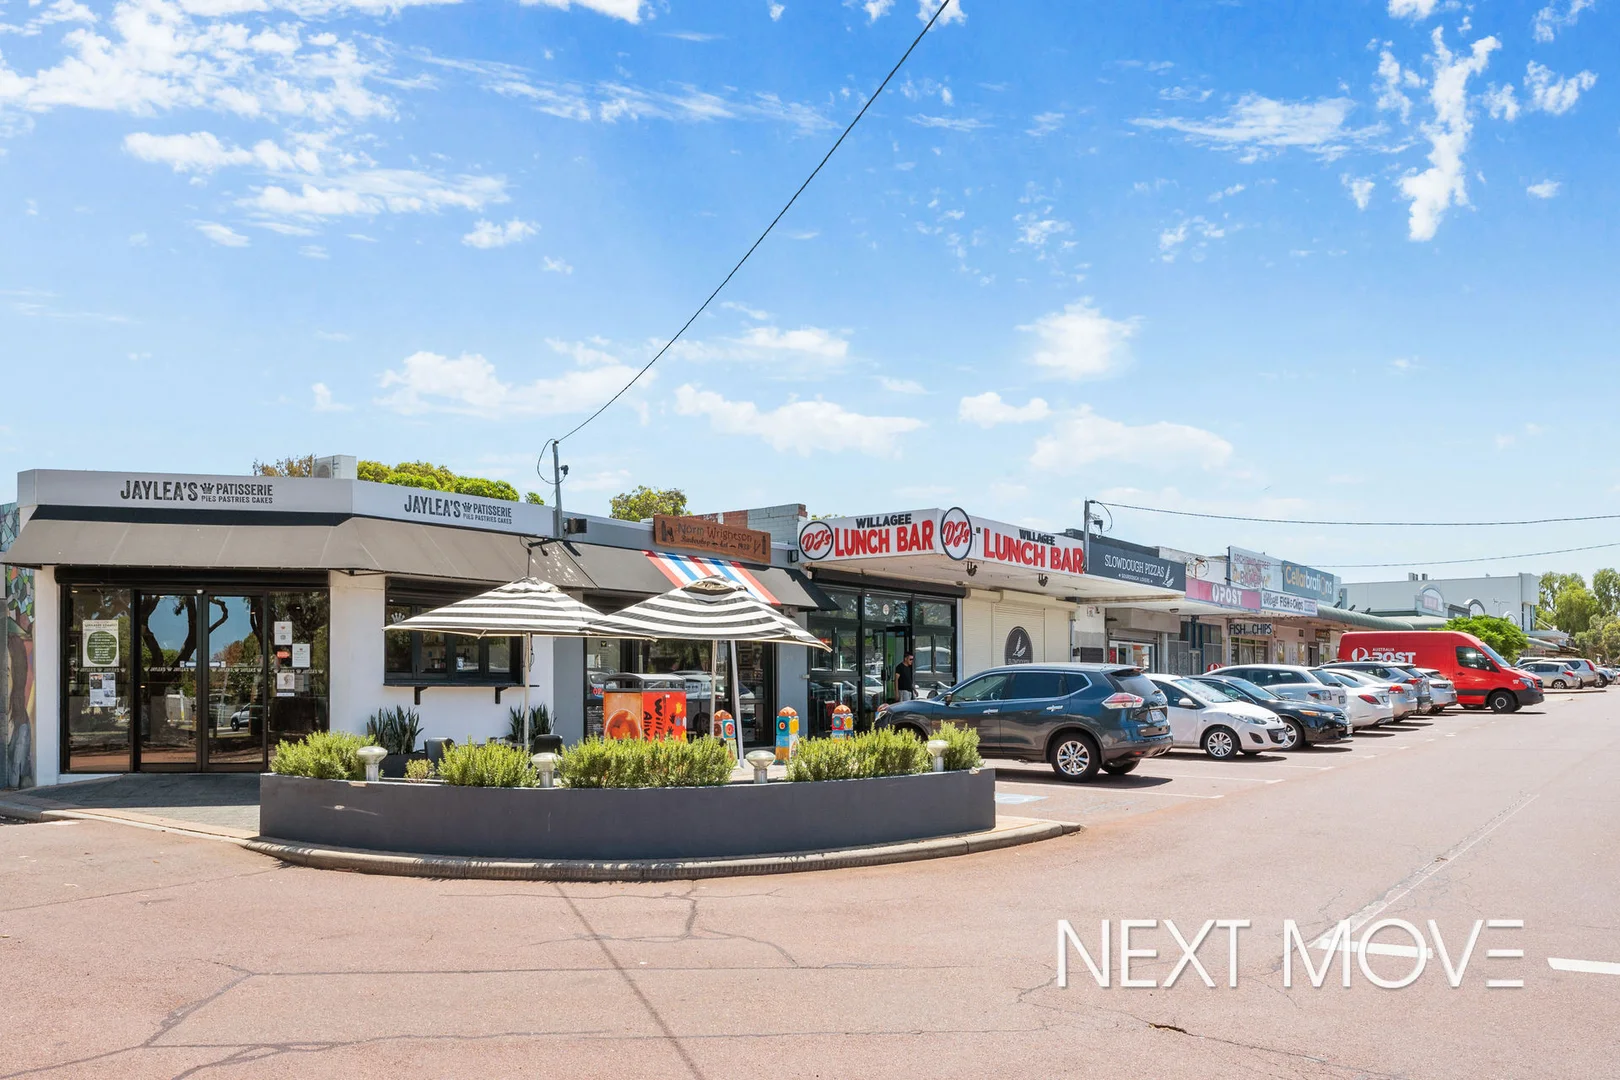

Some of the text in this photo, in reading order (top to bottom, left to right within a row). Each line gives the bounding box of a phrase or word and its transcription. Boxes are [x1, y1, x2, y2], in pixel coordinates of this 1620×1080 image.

[120, 480, 273, 502] JAYLEA'S PATISSERIE
[404, 494, 512, 518] JAYLEA'S PATISSERIE
[463, 512, 474, 520] PIES
[474, 515, 497, 523] PASTRIES
[856, 513, 912, 529] WILLAGEE
[706, 526, 753, 543] Wrightson
[834, 527, 891, 557] LUNCH
[896, 519, 935, 552] BAR
[1019, 528, 1056, 546] WILLAGEE
[983, 527, 1085, 575] LUNCH BAR
[1104, 554, 1165, 578] SLOWDOUGH PIZZAS
[1219, 586, 1242, 605] POST
[1280, 596, 1290, 608] FISH
[1229, 623, 1246, 635] FISH
[1252, 624, 1272, 635] CHIPS
[1372, 651, 1416, 665] POST
